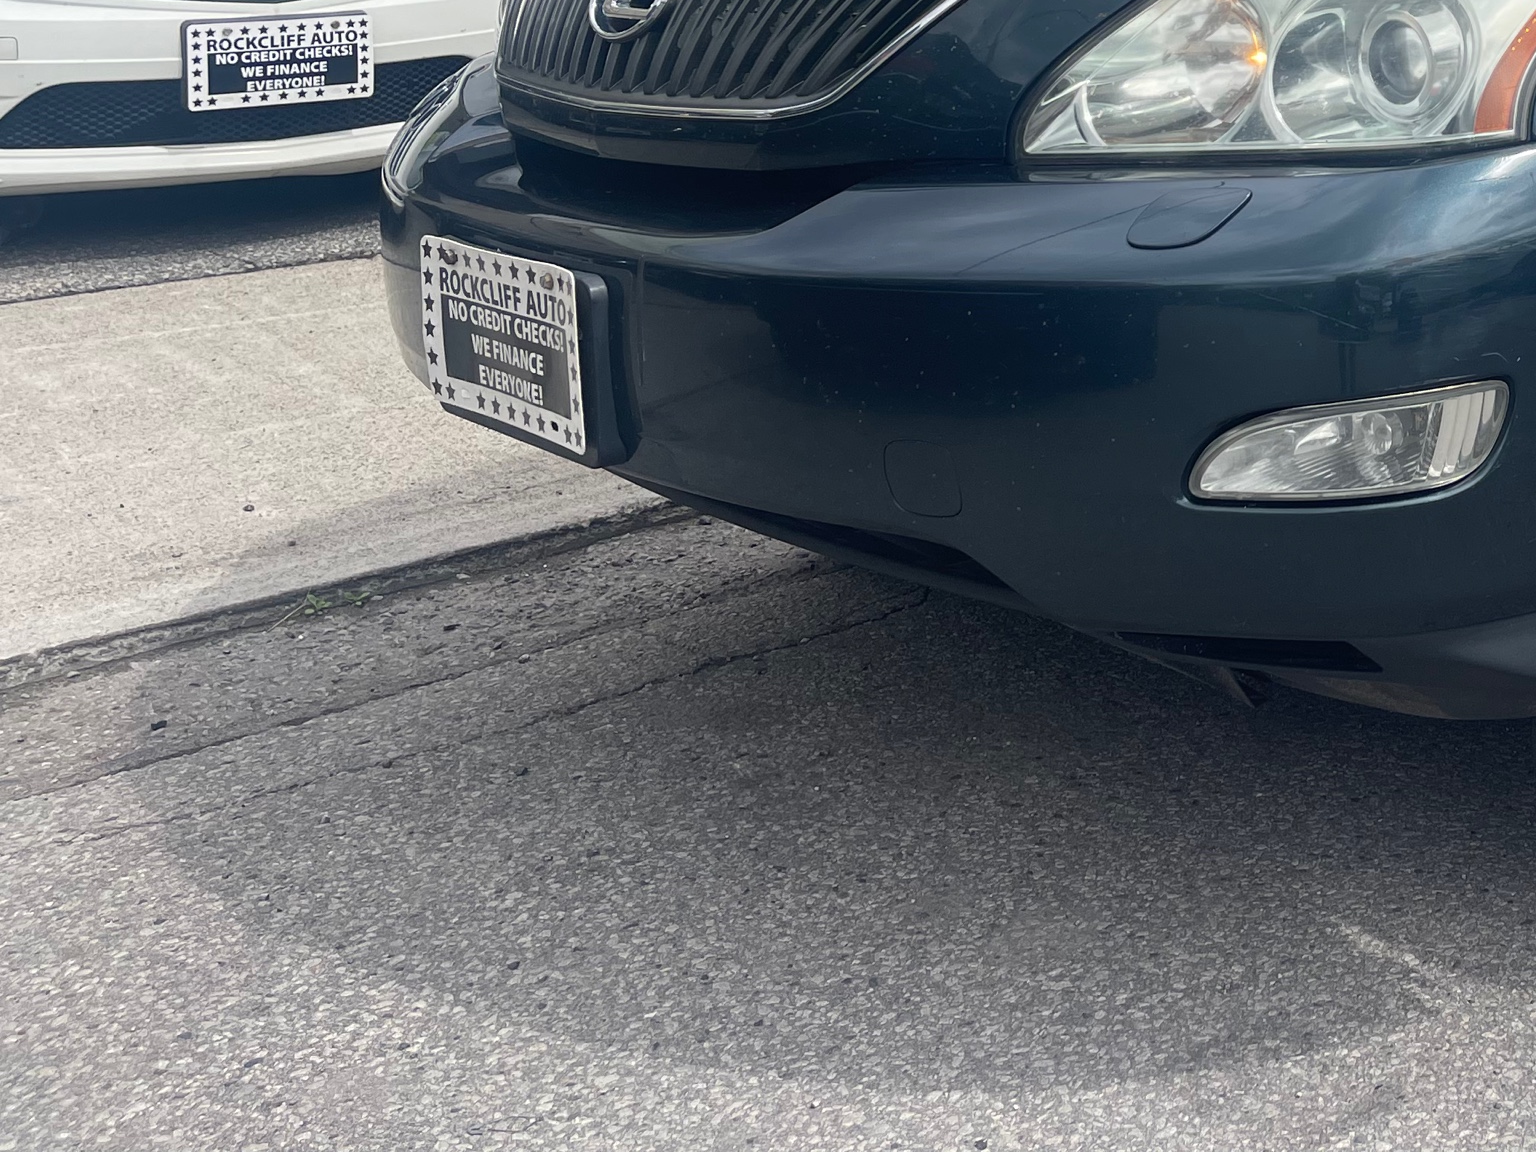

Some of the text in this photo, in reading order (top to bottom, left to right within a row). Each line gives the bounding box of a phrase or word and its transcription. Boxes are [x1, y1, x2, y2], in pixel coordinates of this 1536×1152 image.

[206, 30, 358, 52] ROCKCLIFF AUTO
[215, 44, 353, 65] NO CREDIT CHECKS!
[241, 61, 328, 78] WE FINANCE
[246, 75, 325, 92] EVERYONE!
[439, 266, 567, 326] ROCKCLIFF AUTO
[448, 299, 564, 353] NO CREDIT CHECKS!
[471, 333, 545, 377] WE FINANCE
[479, 364, 544, 406] EVERYONE!
